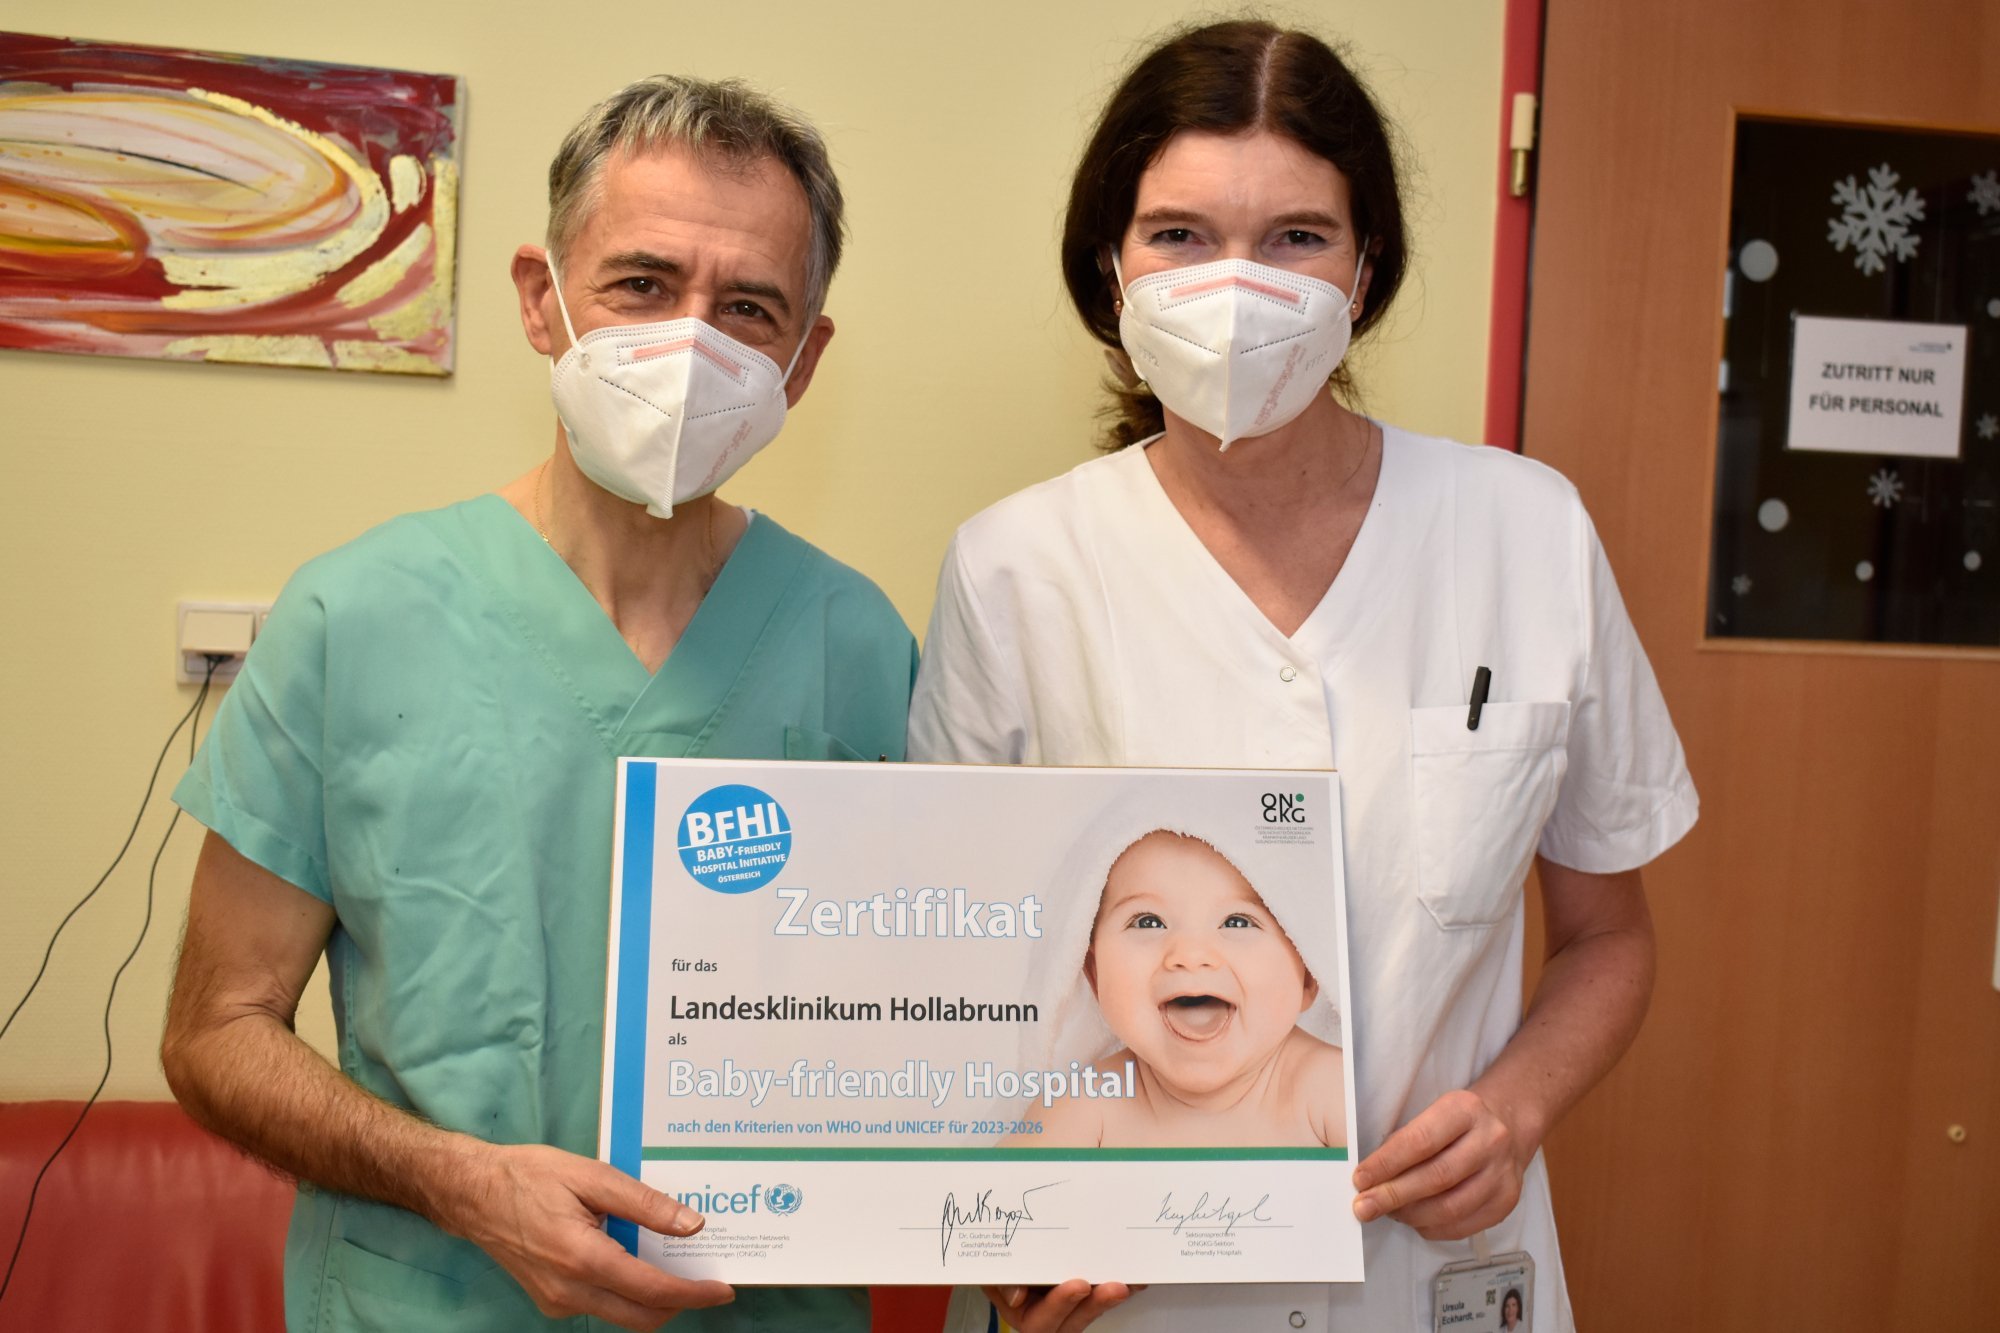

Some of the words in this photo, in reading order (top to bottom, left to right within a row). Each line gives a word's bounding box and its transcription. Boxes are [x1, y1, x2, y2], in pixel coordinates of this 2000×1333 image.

[1821, 363, 1893, 382] ZUTRITT
[1898, 367, 1937, 384] NUR
[1809, 392, 1844, 411] FÜR
[1849, 396, 1943, 418] PERSONAL
[686, 802, 780, 848] BFHI
[1263, 807, 1306, 823] GKG
[718, 870, 761, 883] ÖSTERREICH
[774, 887, 1043, 939] Zertifikat
[672, 958, 691, 972] für
[694, 958, 718, 972] das
[671, 995, 882, 1021] Landesklinikum
[890, 996, 1039, 1022] Hollabrunn
[668, 1032, 687, 1045] als
[668, 1058, 955, 1107] Baby-friendly
[965, 1060, 1136, 1107] Hospital
[667, 1120, 700, 1133] nach
[704, 1120, 731, 1133] den
[734, 1120, 793, 1134] Kriterien
[797, 1123, 823, 1134] von
[826, 1120, 862, 1134] WHO
[865, 1120, 892, 1134] und
[895, 1120, 945, 1134] UNICEF
[948, 1120, 968, 1134] für
[971, 1120, 1044, 1134] 2023-2026
